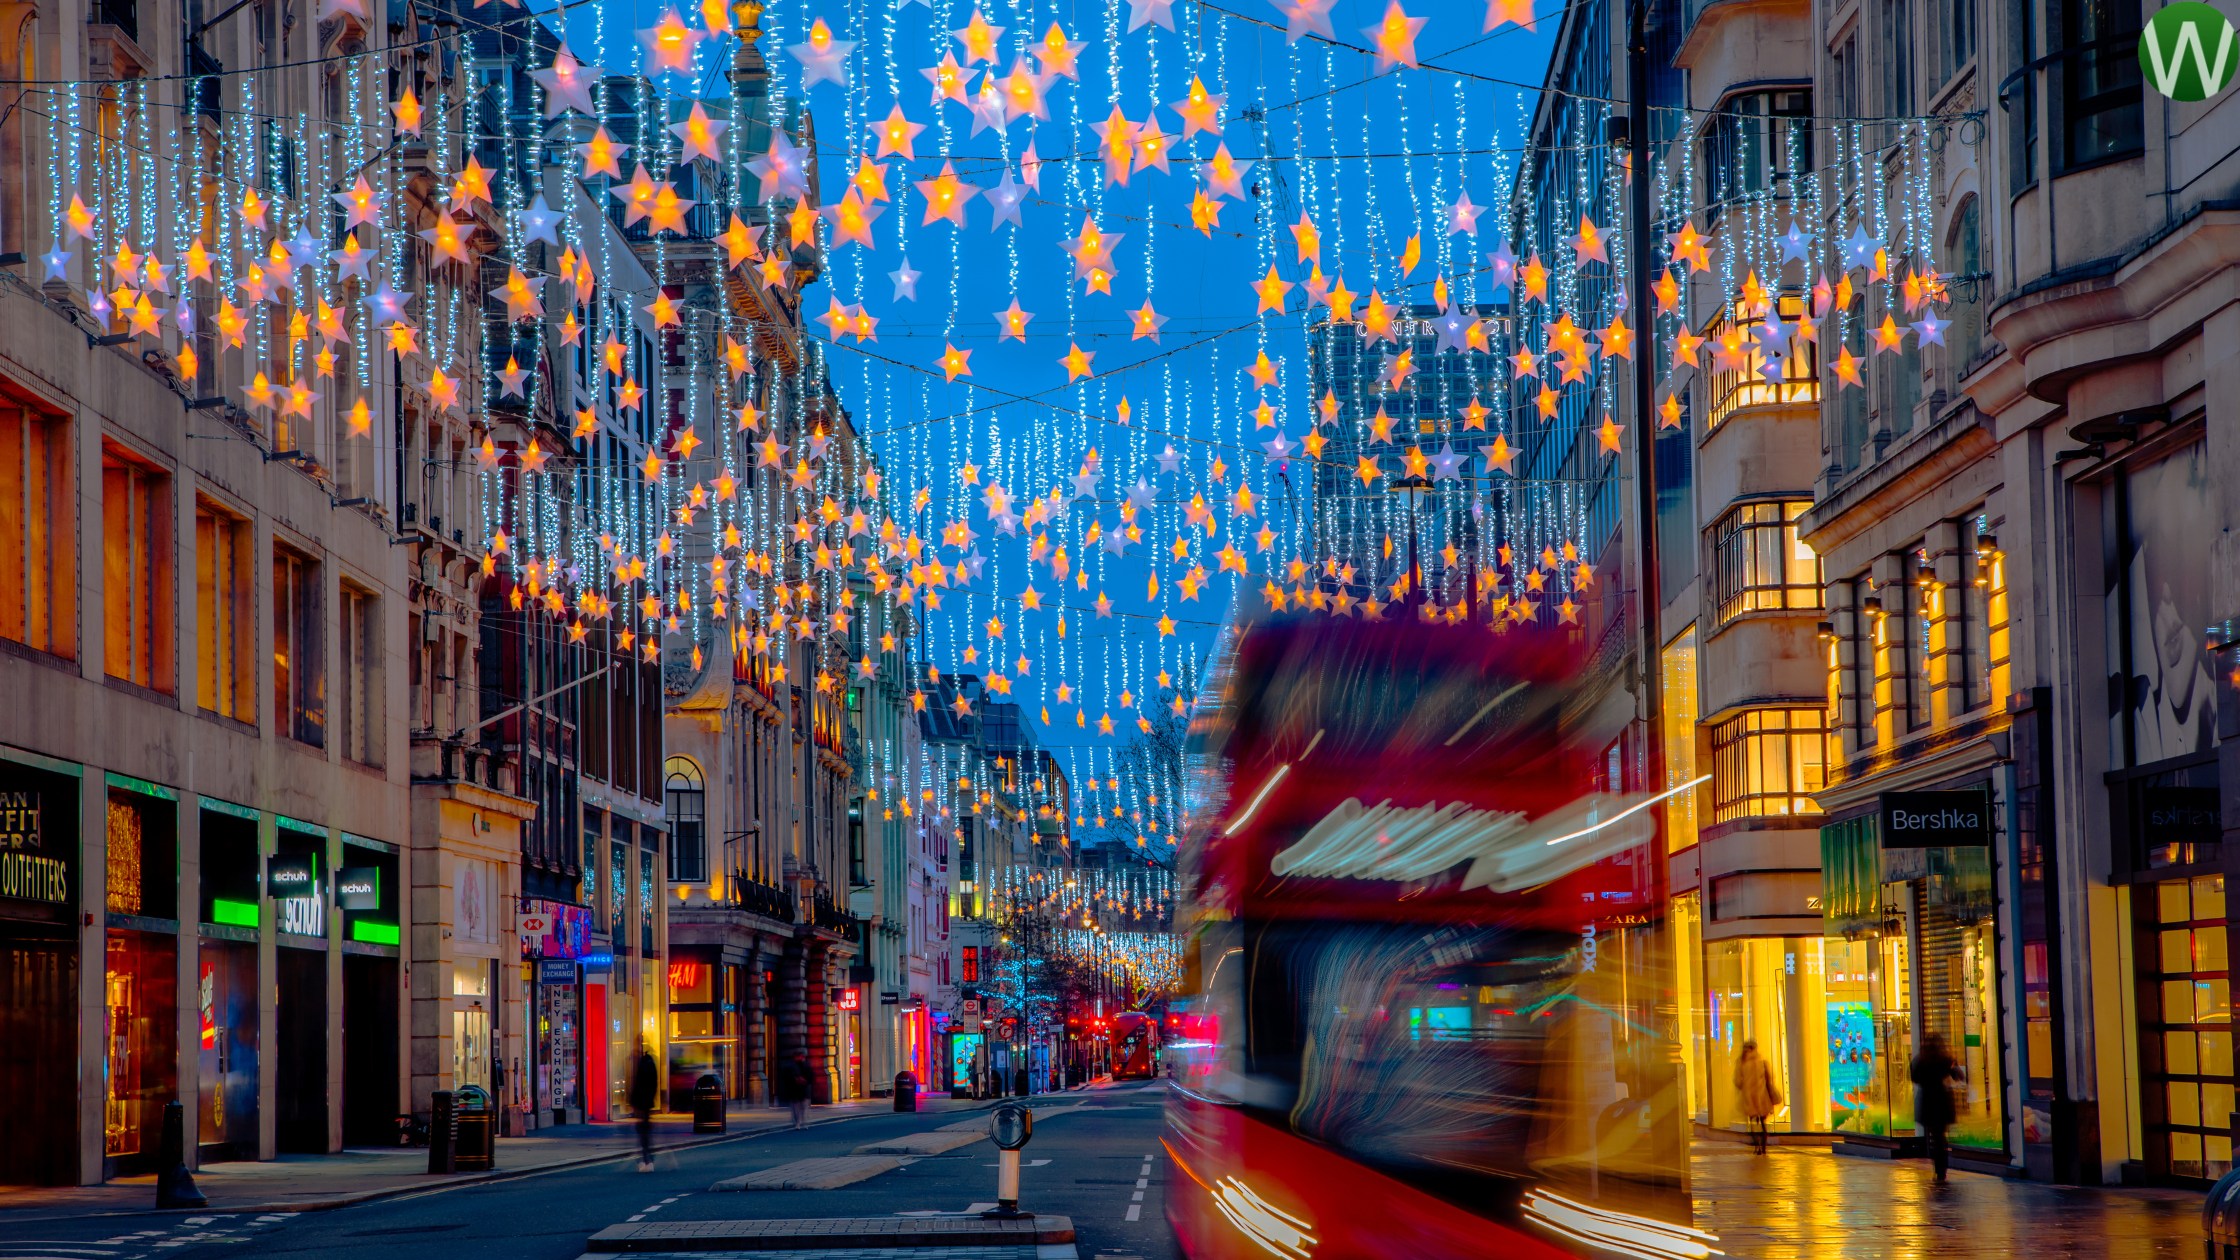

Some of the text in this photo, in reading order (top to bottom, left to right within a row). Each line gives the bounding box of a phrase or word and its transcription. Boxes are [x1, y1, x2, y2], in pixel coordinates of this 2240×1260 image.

[1892, 808, 1979, 830] Bershka
[2, 851, 67, 902] OUTFITTERS
[275, 871, 307, 882] schuh
[341, 883, 372, 893] schuh
[1602, 914, 1649, 924] ZARA
[543, 970, 575, 978] EXCHANGE
[669, 964, 696, 987] H&M
[553, 1028, 562, 1106] EXCHANGE
